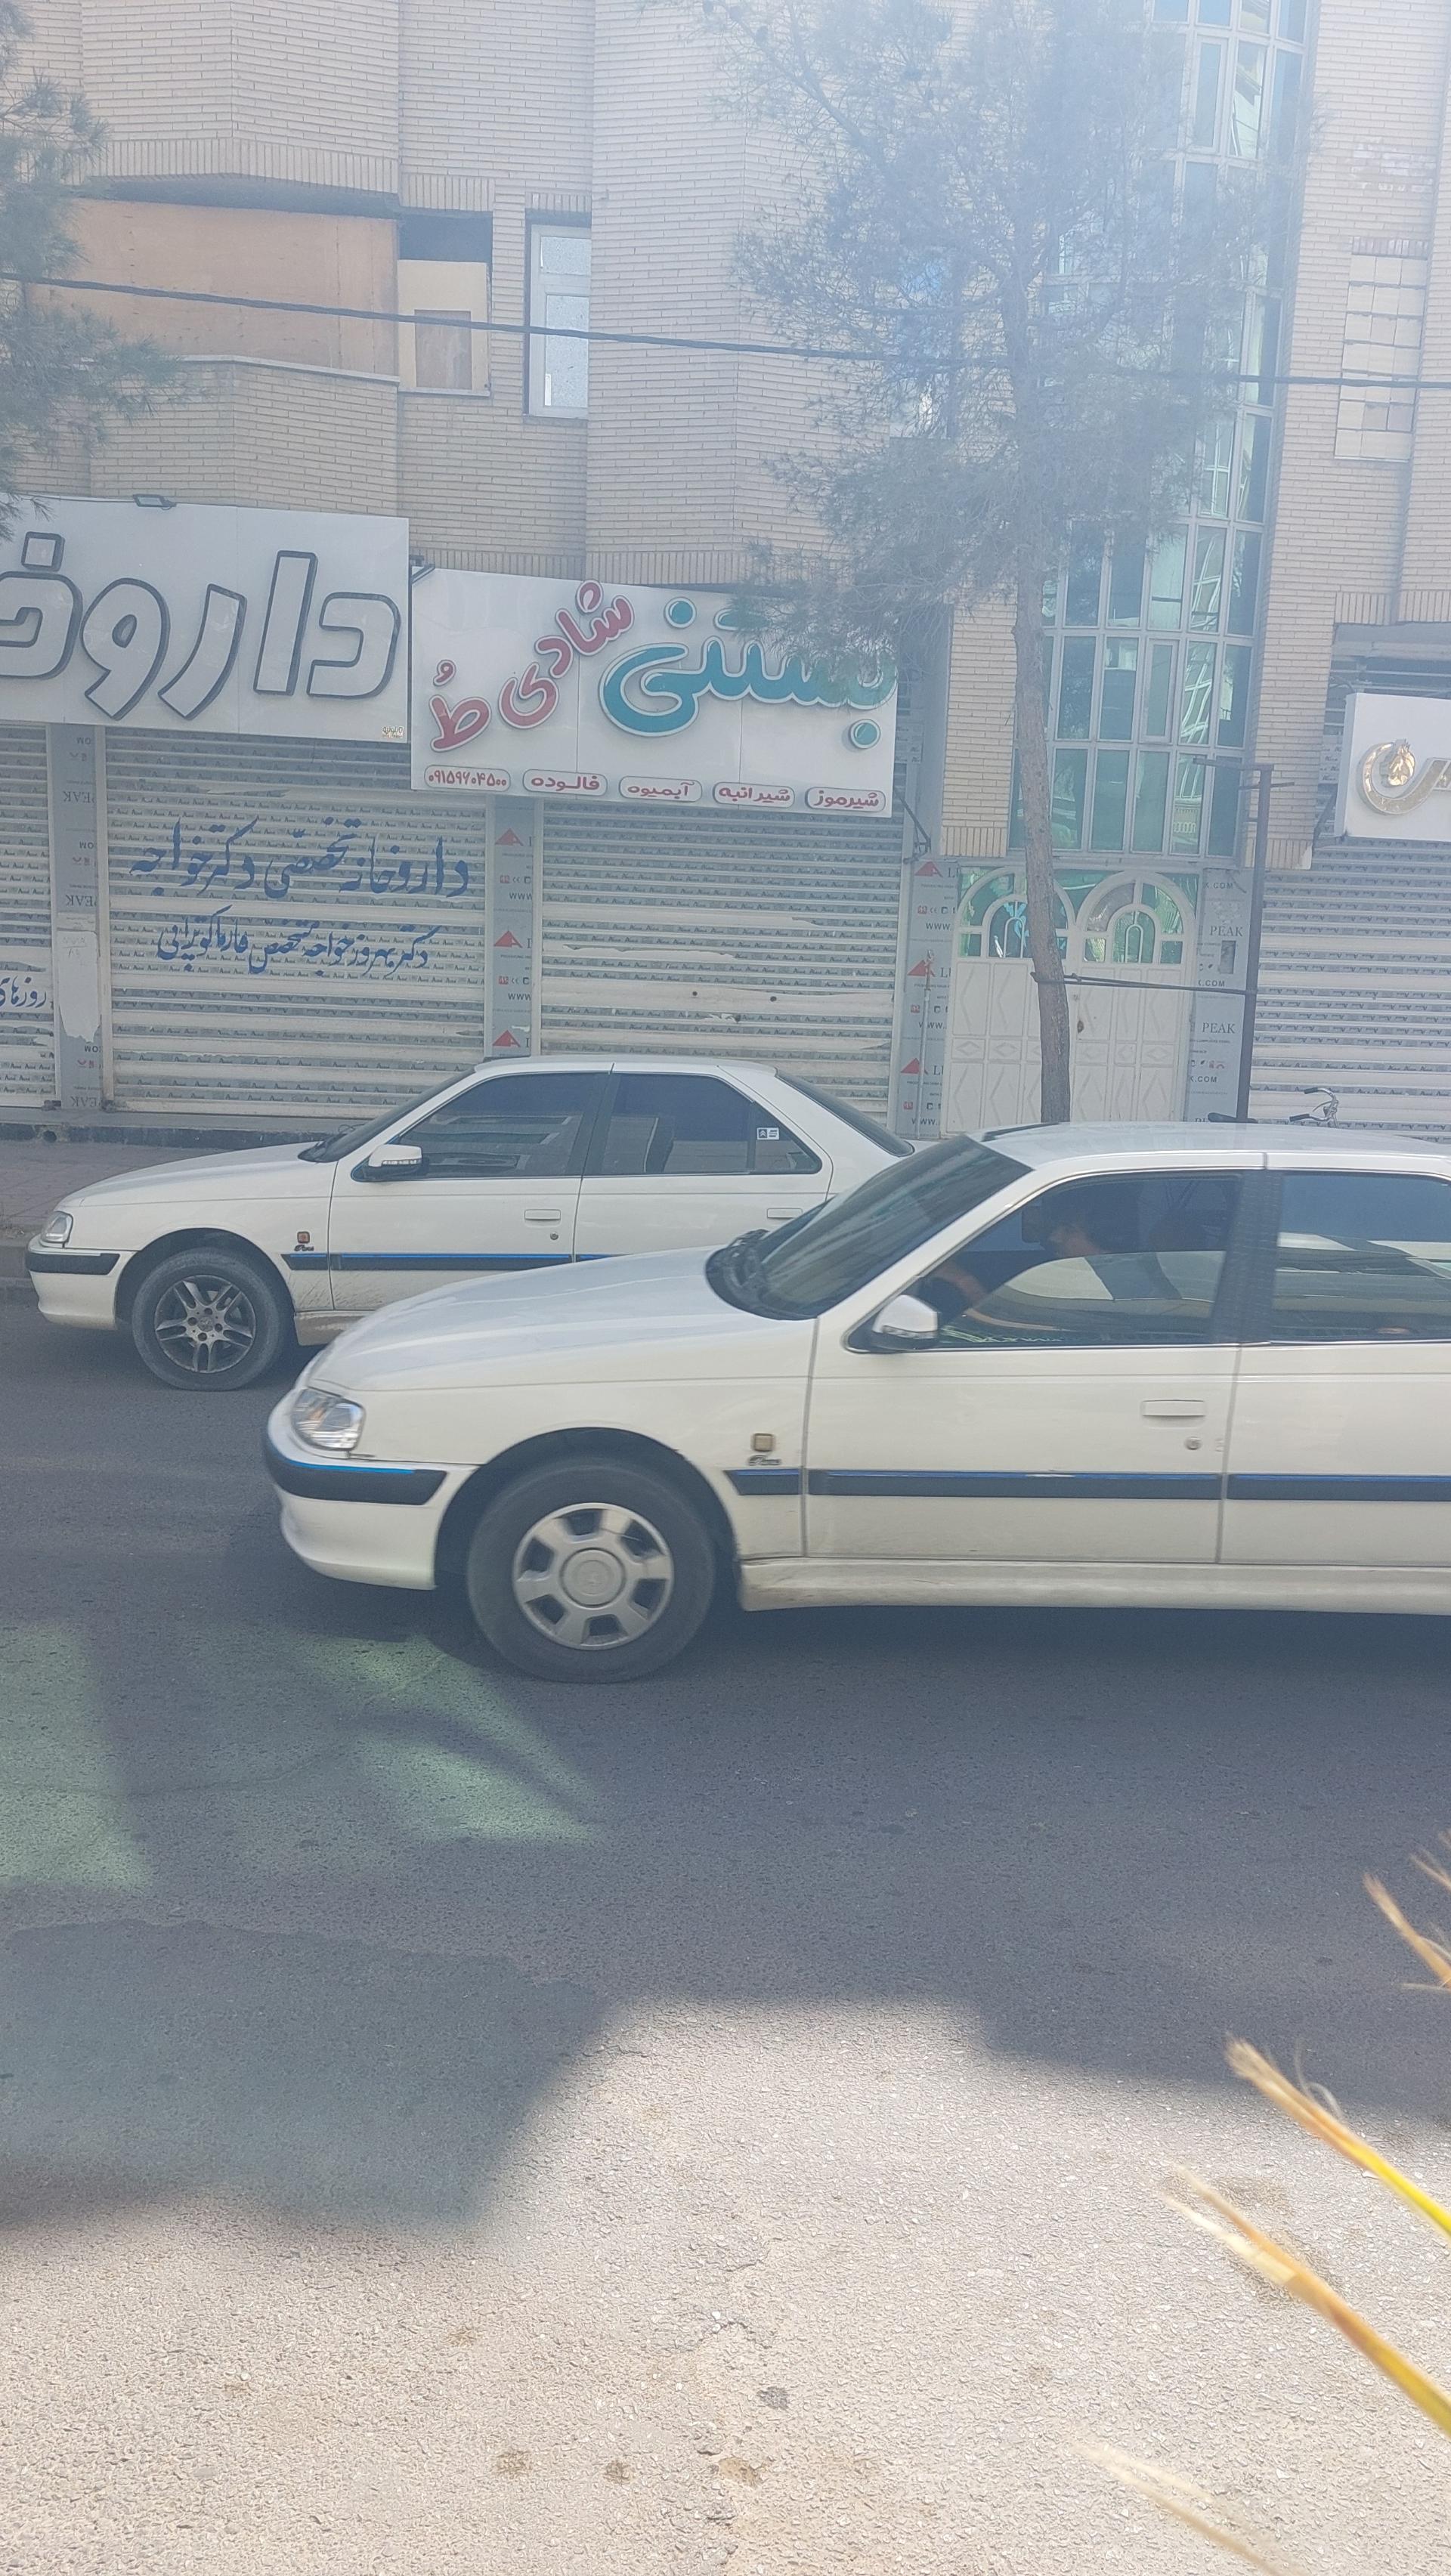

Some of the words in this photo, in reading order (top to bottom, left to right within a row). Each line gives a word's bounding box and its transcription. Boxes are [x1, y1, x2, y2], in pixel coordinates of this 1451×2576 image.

[498, 580, 635, 730] شادی
[599, 595, 899, 748] بستنی
[626, 782, 695, 798] آبمیوه
[813, 790, 880, 809] شیرموز
[196, 815, 260, 896] دکتر
[339, 835, 469, 898] داروخانه
[384, 925, 442, 977] دکتر
[1210, 925, 1243, 937] PEAK
[1202, 1022, 1236, 1034] PEAK
